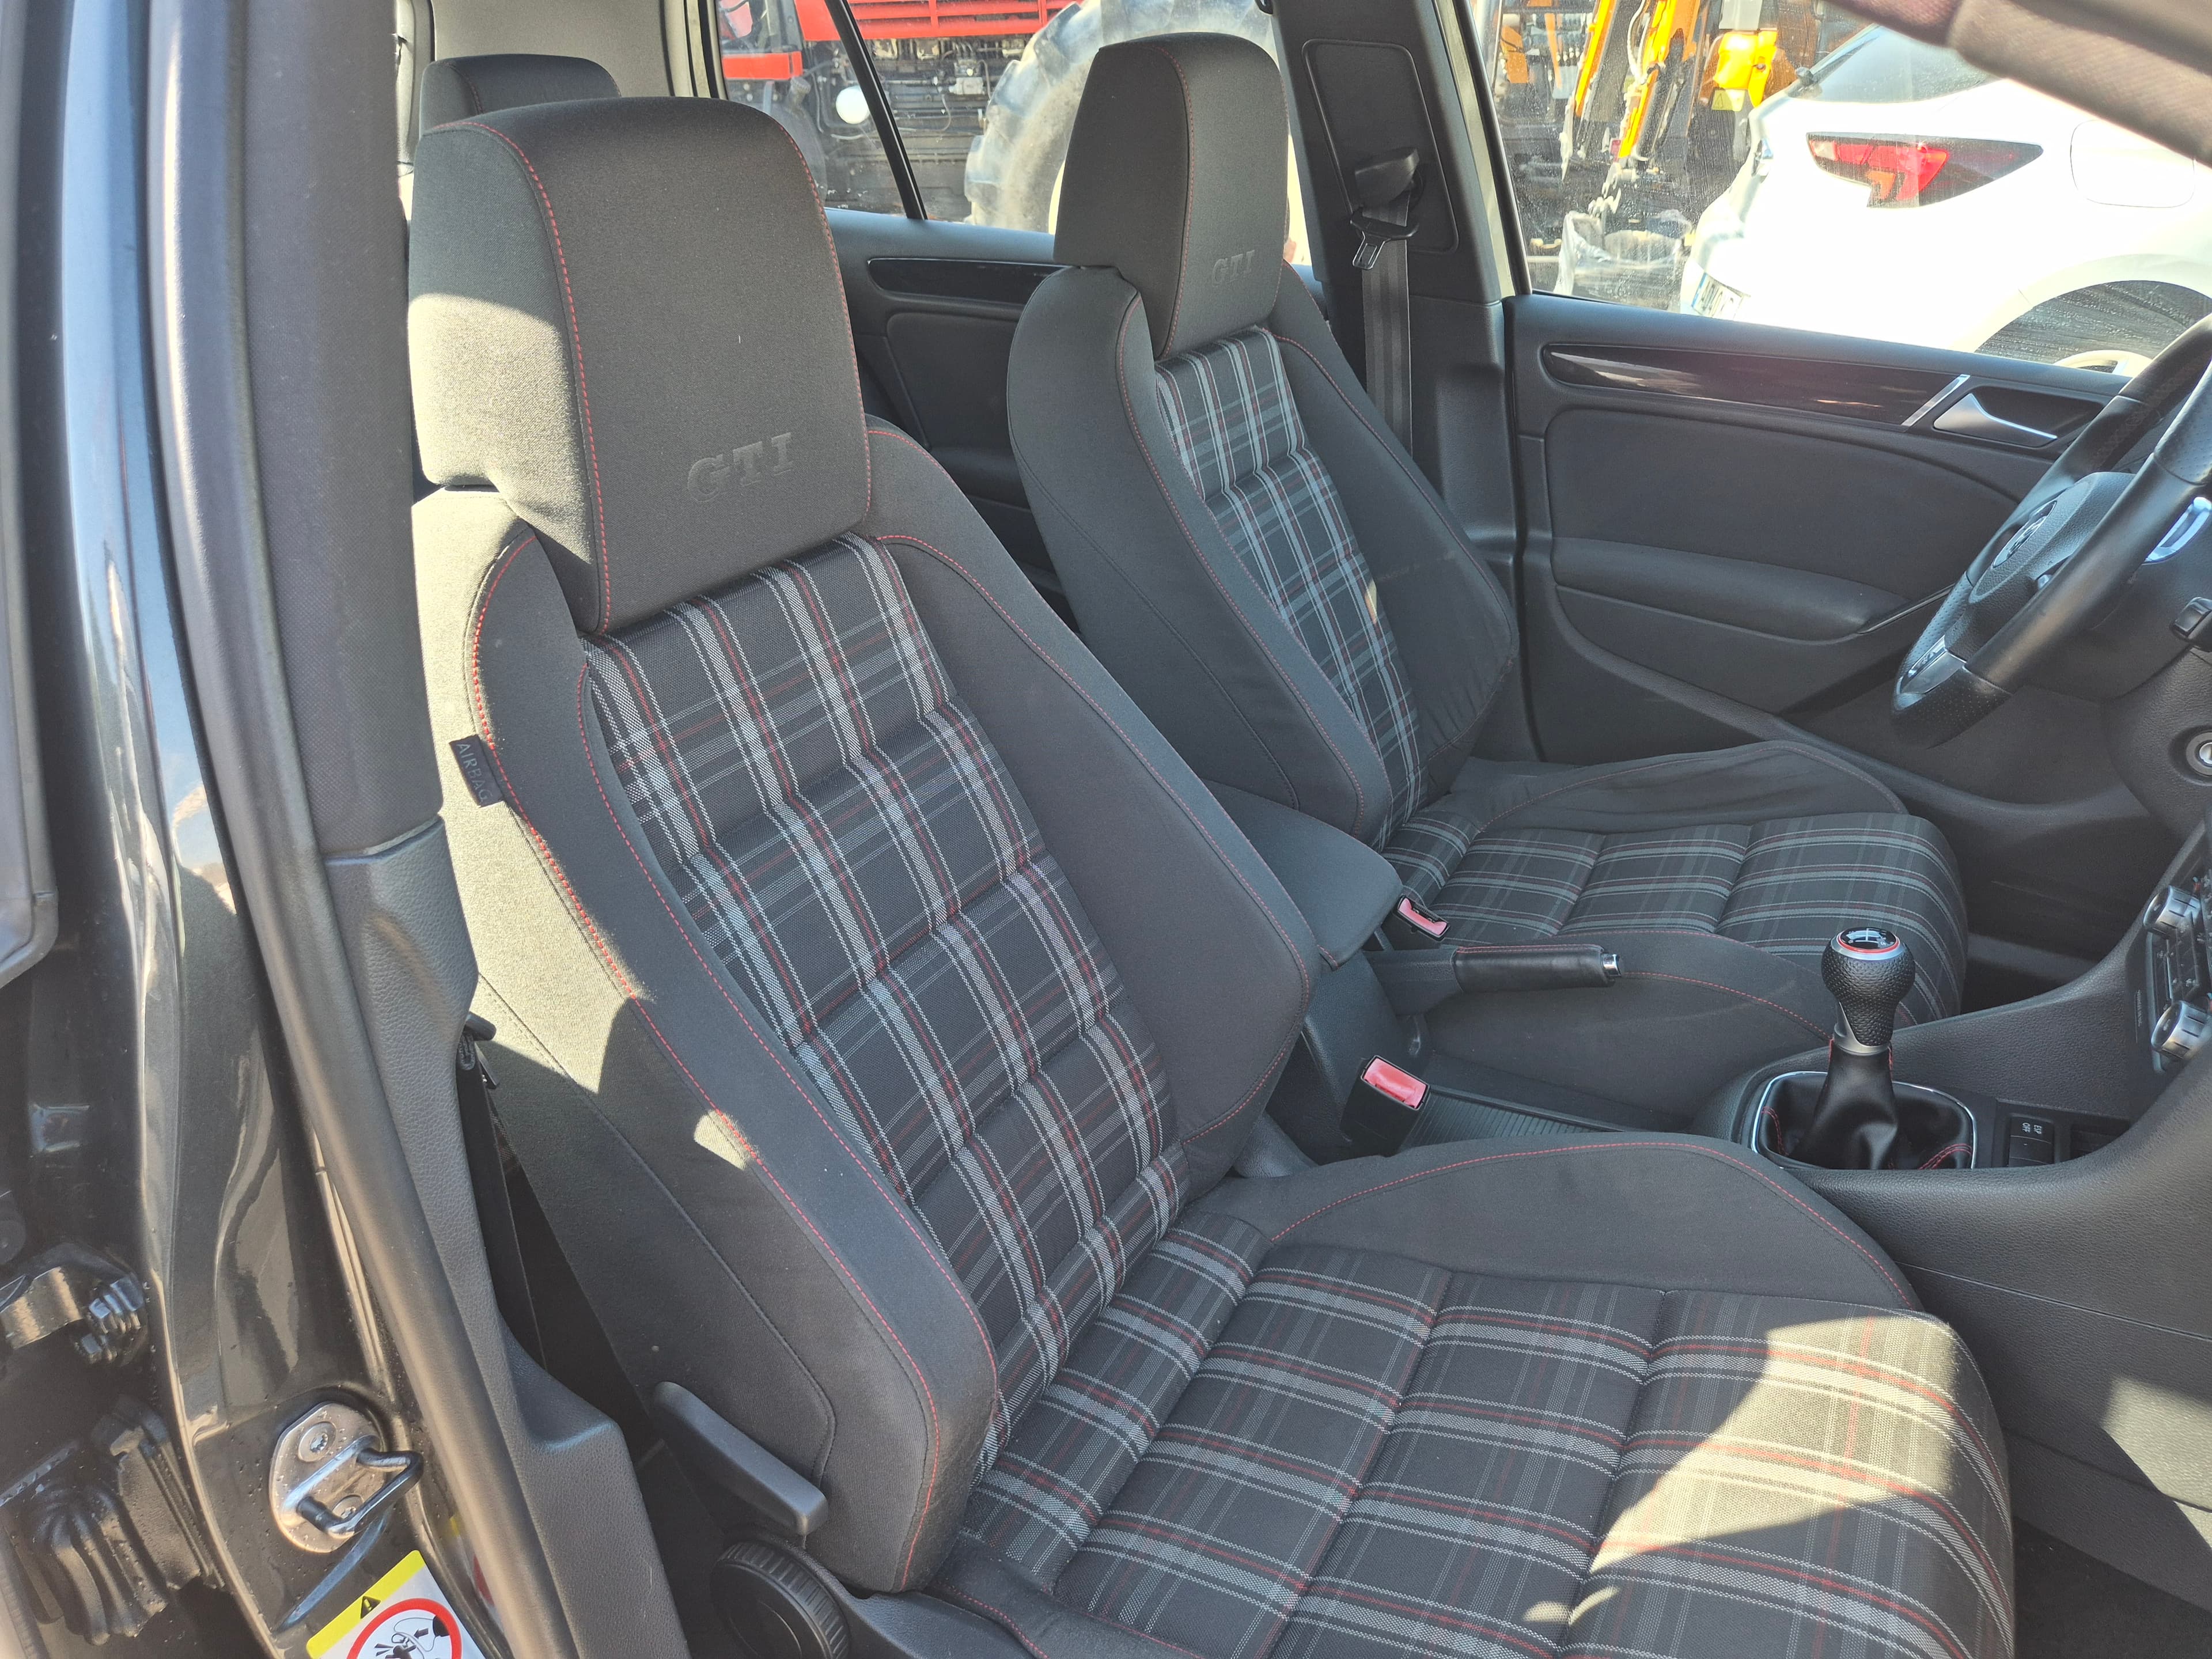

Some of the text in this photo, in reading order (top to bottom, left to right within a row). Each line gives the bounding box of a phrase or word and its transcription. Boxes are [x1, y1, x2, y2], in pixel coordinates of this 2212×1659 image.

[1212, 249, 1255, 287] GTI
[688, 433, 792, 502] GTI
[456, 743, 493, 801] AIRBAG
[2022, 1122, 2031, 1133] OFF
[2033, 1124, 2042, 1134] ESP
